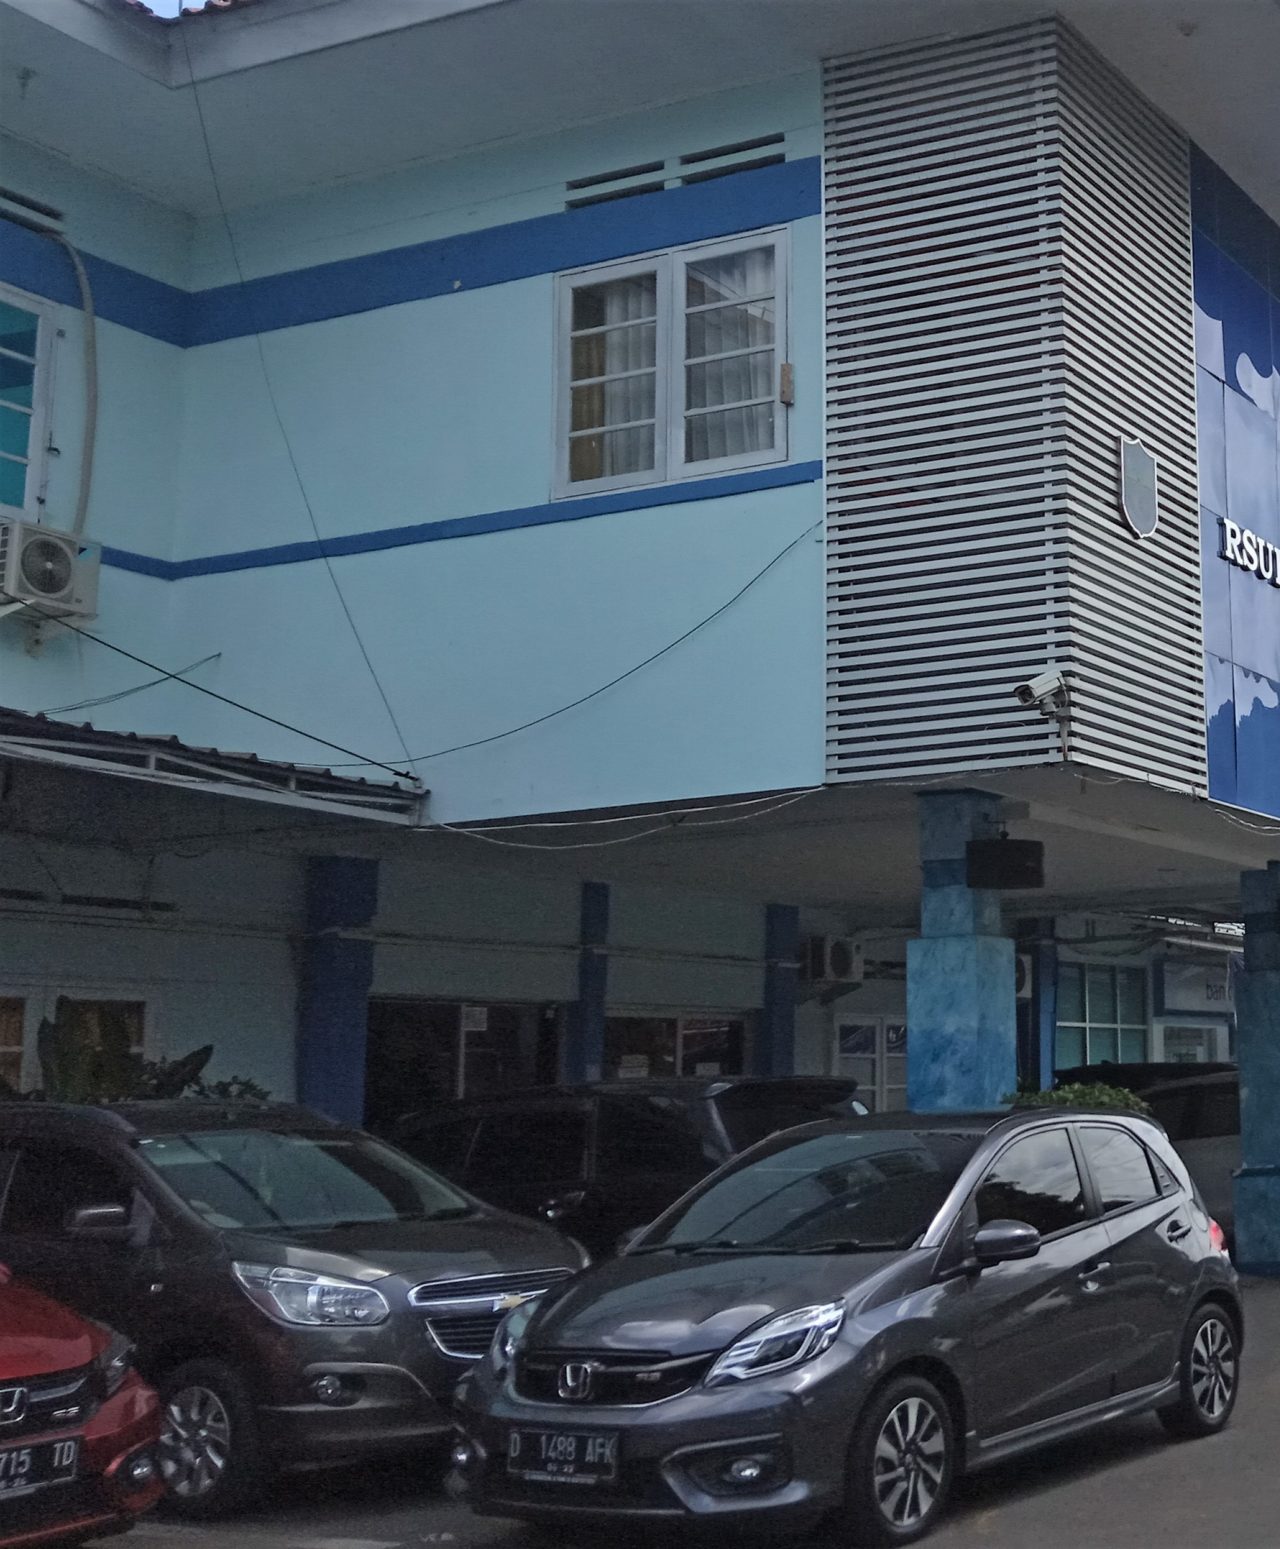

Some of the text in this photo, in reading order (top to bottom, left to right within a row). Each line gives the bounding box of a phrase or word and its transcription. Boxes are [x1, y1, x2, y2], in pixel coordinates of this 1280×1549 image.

[53, 1441, 76, 1468] TD
[510, 1433, 616, 1464] D 1488 AFK
